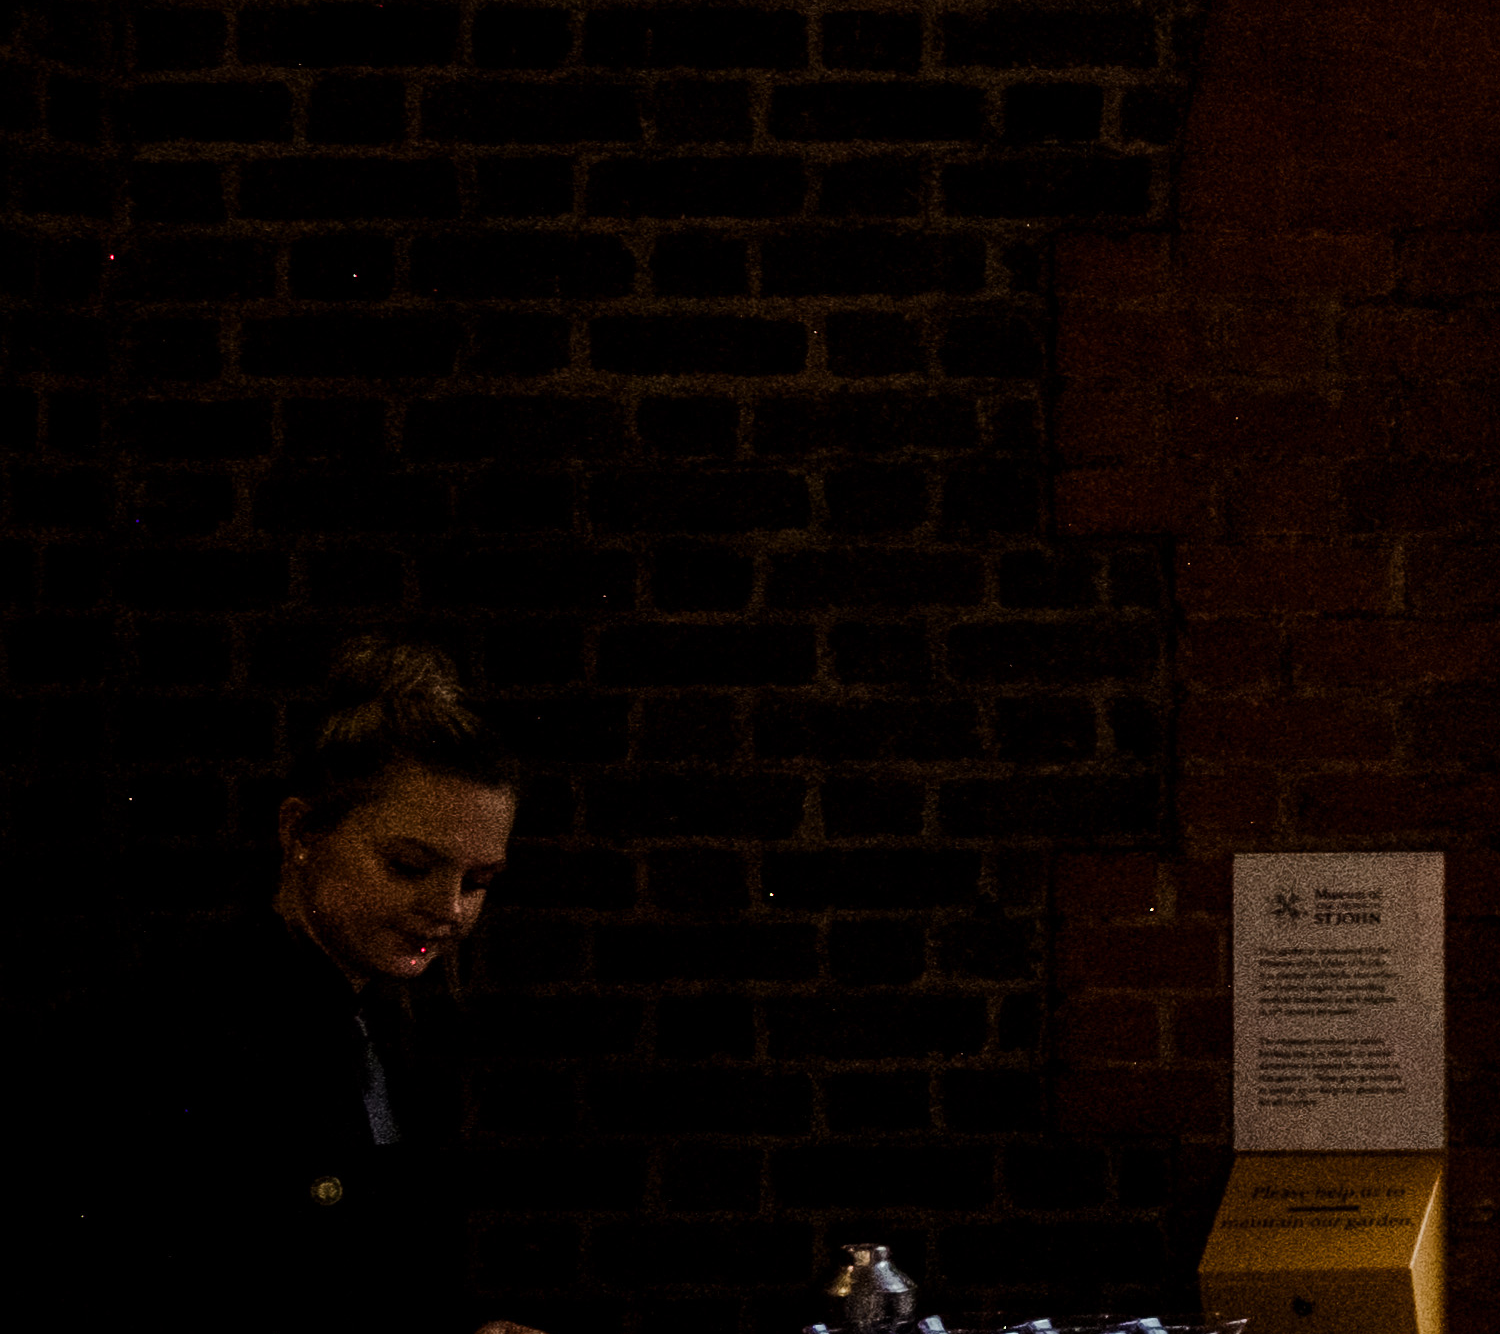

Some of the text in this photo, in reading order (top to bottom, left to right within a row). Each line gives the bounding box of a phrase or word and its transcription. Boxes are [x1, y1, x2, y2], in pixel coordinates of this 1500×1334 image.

[1334, 912, 1382, 926] JOHN
[1251, 1184, 1406, 1203] Please help us to
[1220, 1217, 1304, 1230] maintain
[1308, 1217, 1341, 1229] our
